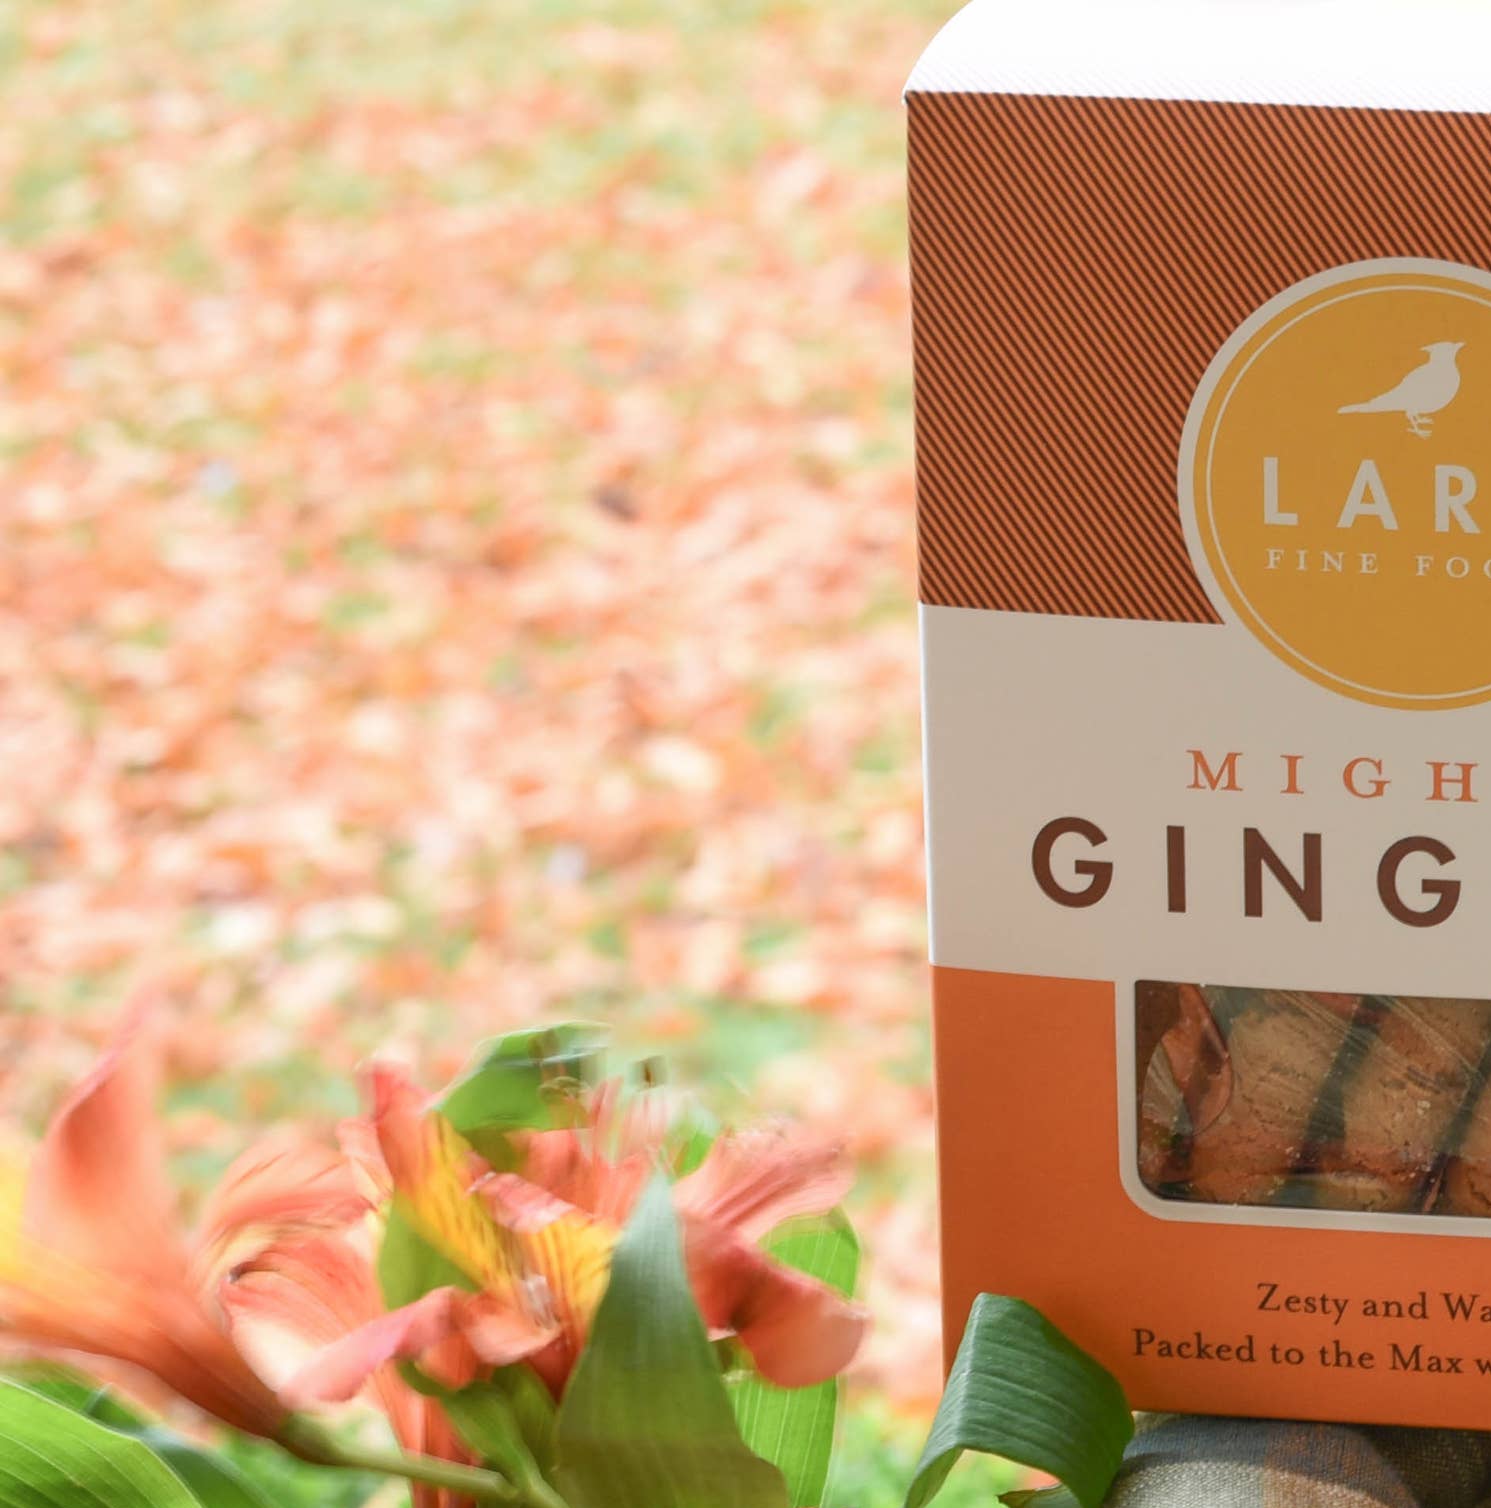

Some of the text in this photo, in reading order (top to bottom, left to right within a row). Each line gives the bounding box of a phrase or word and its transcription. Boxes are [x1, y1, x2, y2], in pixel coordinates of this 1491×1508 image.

[1267, 548, 1379, 574] FINE
[1257, 1283, 1348, 1324] Zesty
[1363, 1292, 1428, 1320] and
[1133, 1328, 1255, 1364] Packed
[1269, 1343, 1304, 1366] to
[1318, 1341, 1375, 1369] the
[1390, 1344, 1461, 1375] Max
